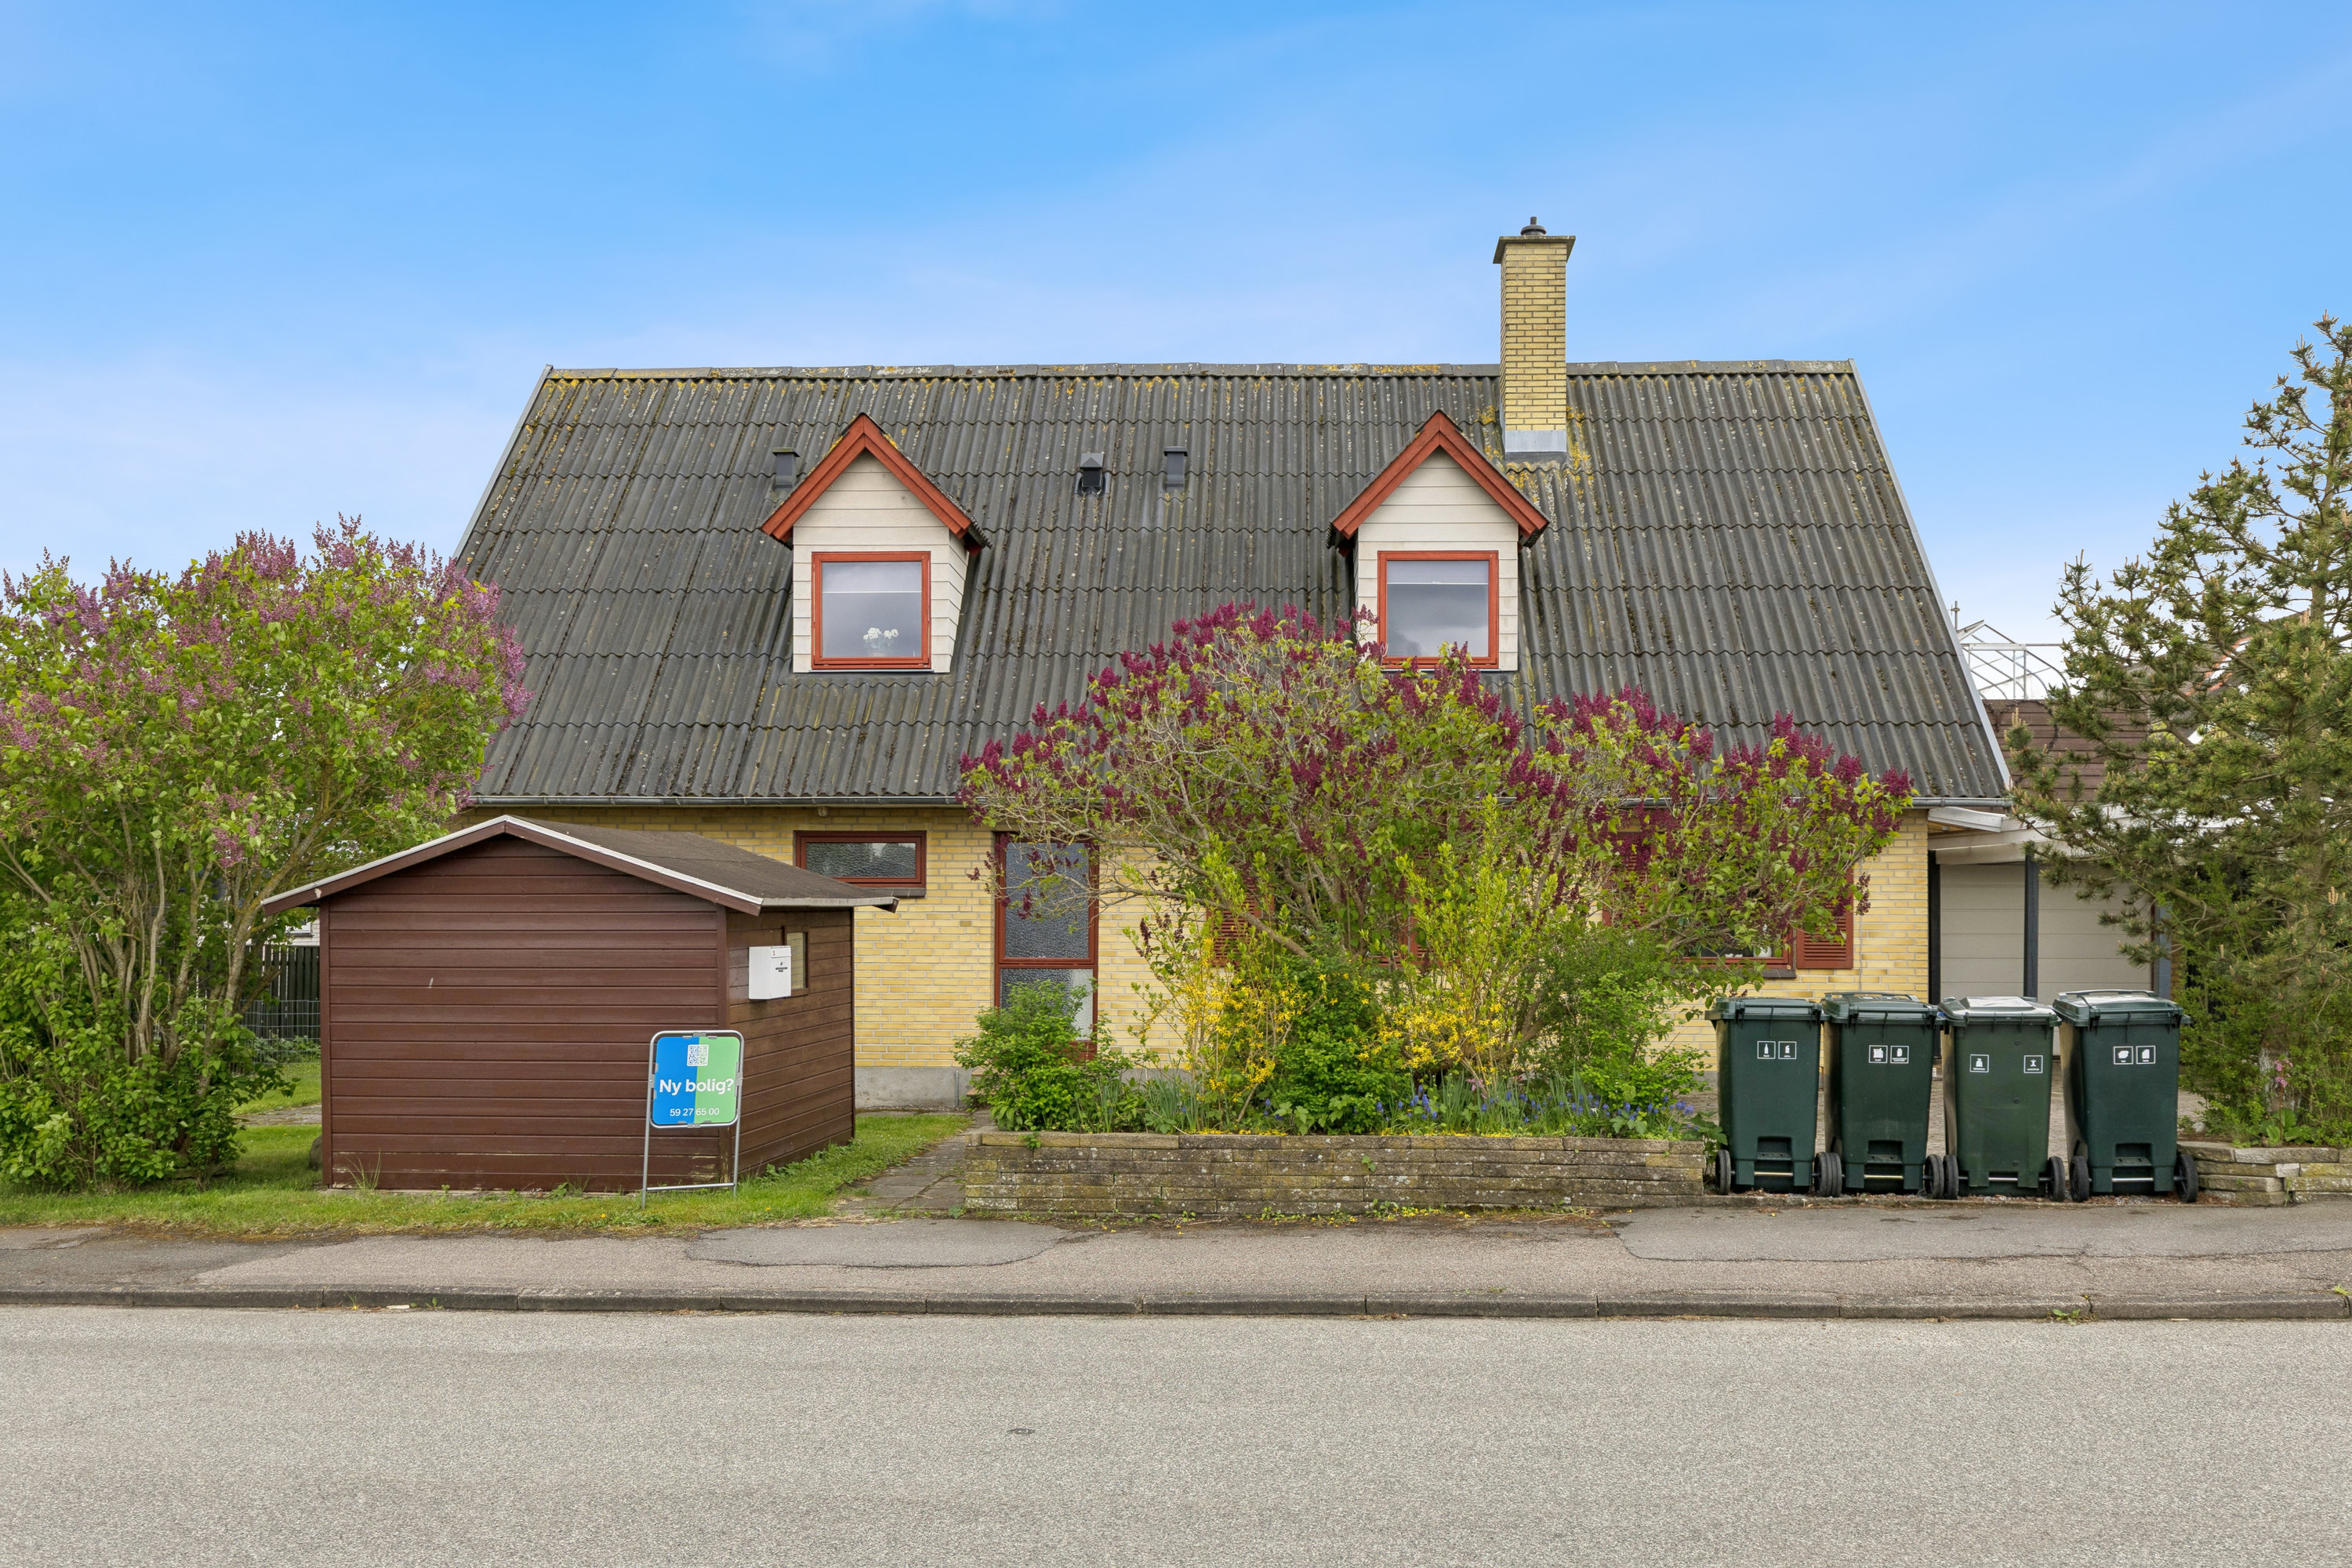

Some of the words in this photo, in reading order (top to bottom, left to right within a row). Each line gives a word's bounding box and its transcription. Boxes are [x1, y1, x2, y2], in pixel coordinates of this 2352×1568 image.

[659, 1079, 682, 1096] Ny
[685, 1078, 735, 1095] bolig?
[670, 1108, 681, 1116] 59
[682, 1108, 694, 1116] 27
[708, 1107, 720, 1116] 00
